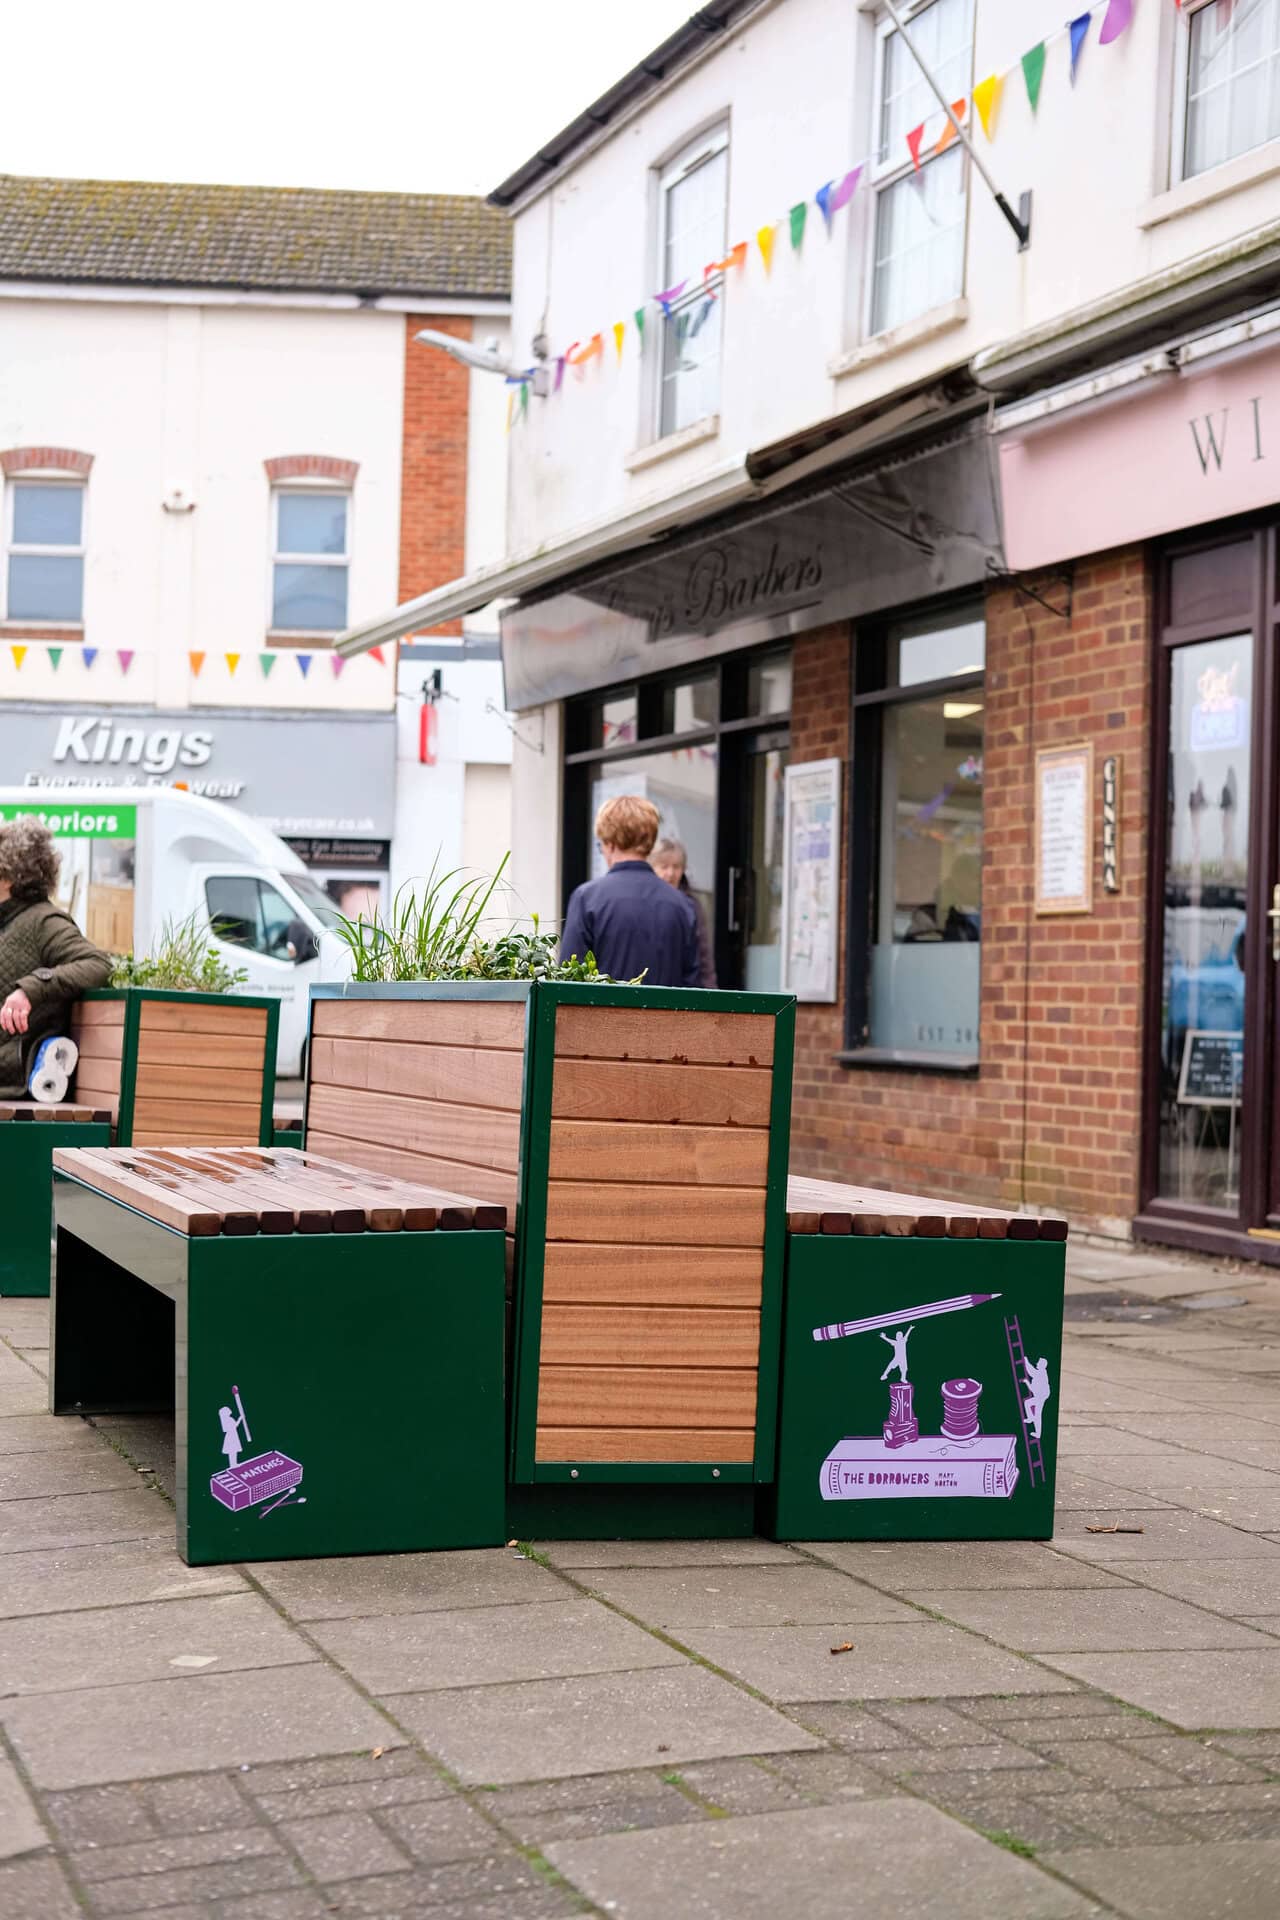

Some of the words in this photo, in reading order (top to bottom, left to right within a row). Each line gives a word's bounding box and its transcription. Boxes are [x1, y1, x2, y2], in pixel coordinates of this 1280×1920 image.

[52, 717, 213, 774] Kings
[16, 810, 118, 832] teriors
[1103, 757, 1116, 892] CINEMA
[240, 1458, 285, 1480] MATCHES
[844, 1472, 865, 1485] THE
[868, 1472, 930, 1486] BORROWERS
[938, 1472, 955, 1480] MARY
[934, 1479, 958, 1487] NORTON
